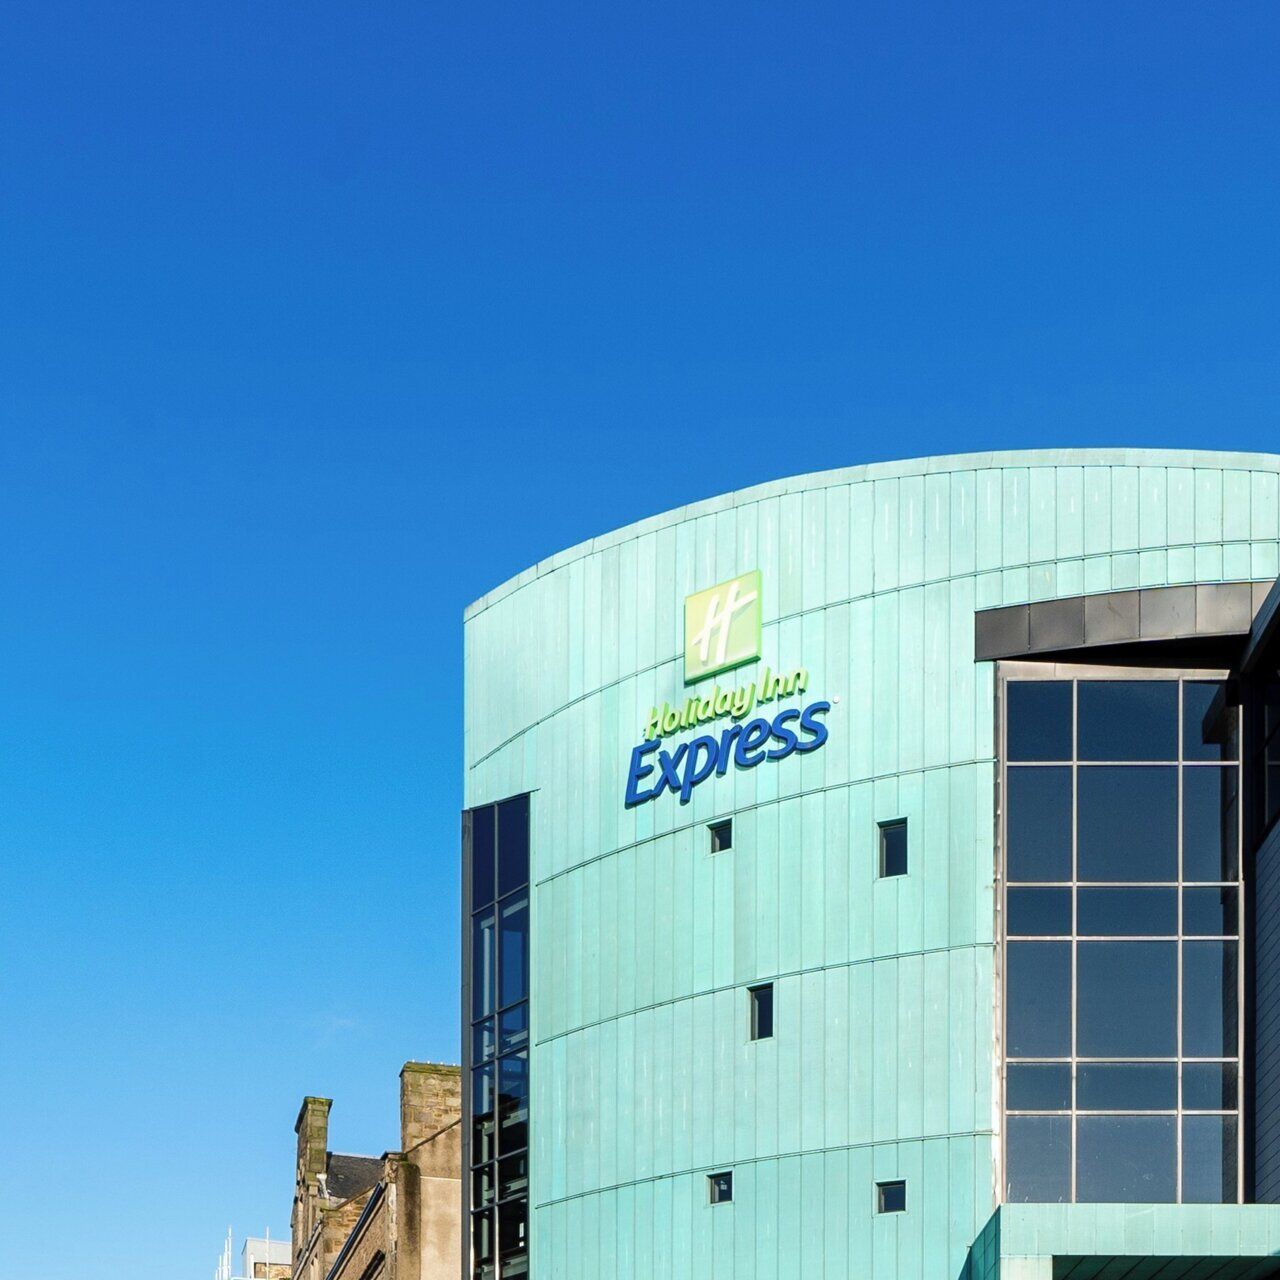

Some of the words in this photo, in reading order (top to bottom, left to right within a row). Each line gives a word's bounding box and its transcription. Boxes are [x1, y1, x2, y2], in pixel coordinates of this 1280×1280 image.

[644, 682, 756, 740] Holiday
[756, 667, 809, 705] Inn
[624, 700, 832, 809] Express
